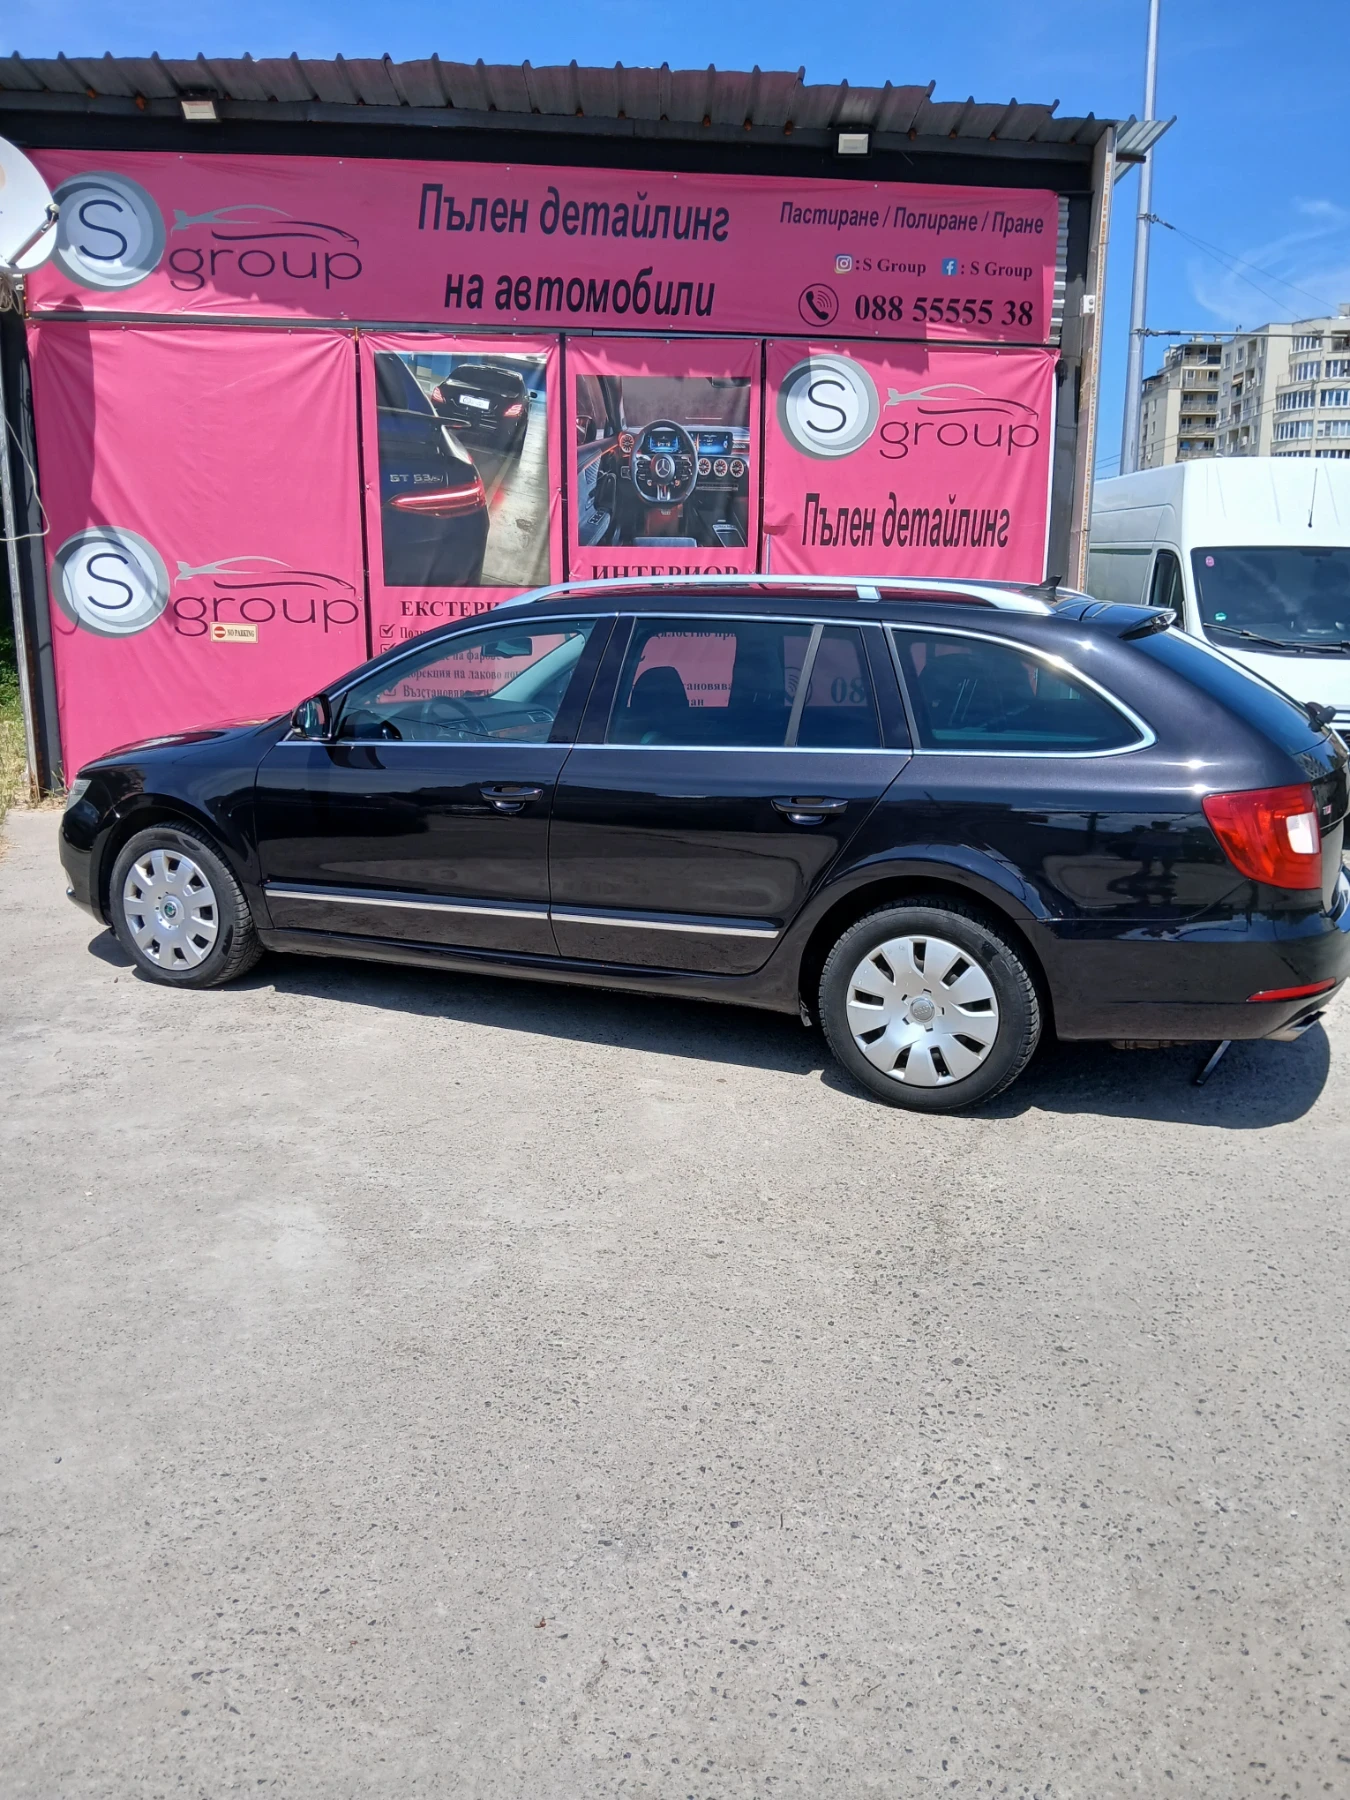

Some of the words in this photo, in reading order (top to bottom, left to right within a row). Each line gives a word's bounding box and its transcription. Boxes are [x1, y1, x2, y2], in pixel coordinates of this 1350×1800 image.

[418, 183, 528, 234] Пълен
[539, 186, 730, 242] детайлинг
[780, 201, 880, 231] Пастиране
[893, 207, 979, 236] Полиране
[992, 211, 1044, 239] Пране
[78, 199, 128, 260] S
[168, 246, 363, 292] group
[877, 259, 926, 277] Group
[984, 262, 1033, 281] Group
[444, 272, 484, 309] на
[495, 266, 716, 317] автомобили
[855, 295, 903, 321] 088
[912, 297, 993, 325] 55555
[1001, 300, 1034, 326] 38
[806, 379, 847, 433] S
[879, 421, 1040, 460] group
[802, 493, 876, 547] Пълен
[882, 491, 1011, 548] детайлинг
[87, 553, 134, 610] S
[173, 595, 360, 637] group
[235, 629, 254, 637] PARKING
[454, 670, 465, 679] на
